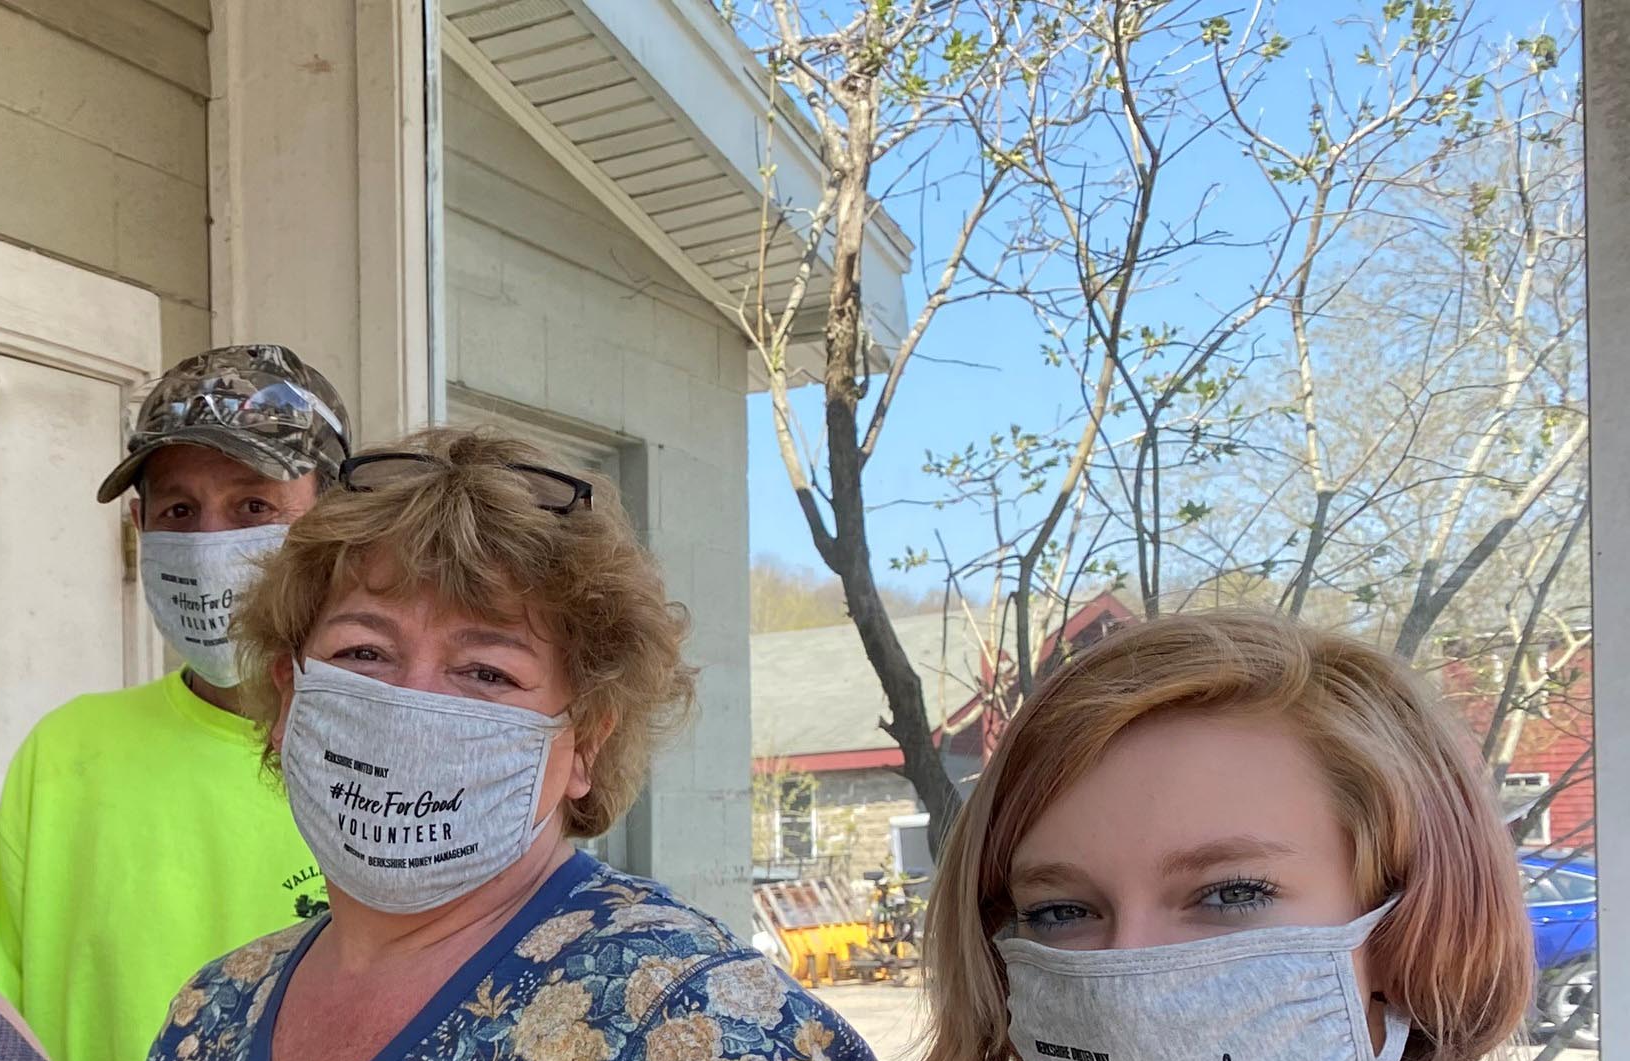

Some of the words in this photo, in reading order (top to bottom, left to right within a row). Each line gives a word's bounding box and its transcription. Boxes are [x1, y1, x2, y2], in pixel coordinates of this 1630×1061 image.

[172, 588, 233, 613] #HereForG
[180, 613, 233, 631] VOLUNT
[330, 780, 465, 818] #HereForGood
[338, 813, 452, 844] VOLUNTEER
[368, 856, 407, 869] BERKSHIRE
[409, 856, 432, 869] MONEY
[433, 842, 479, 864] MANAGEMENT
[282, 866, 322, 890] VALL
